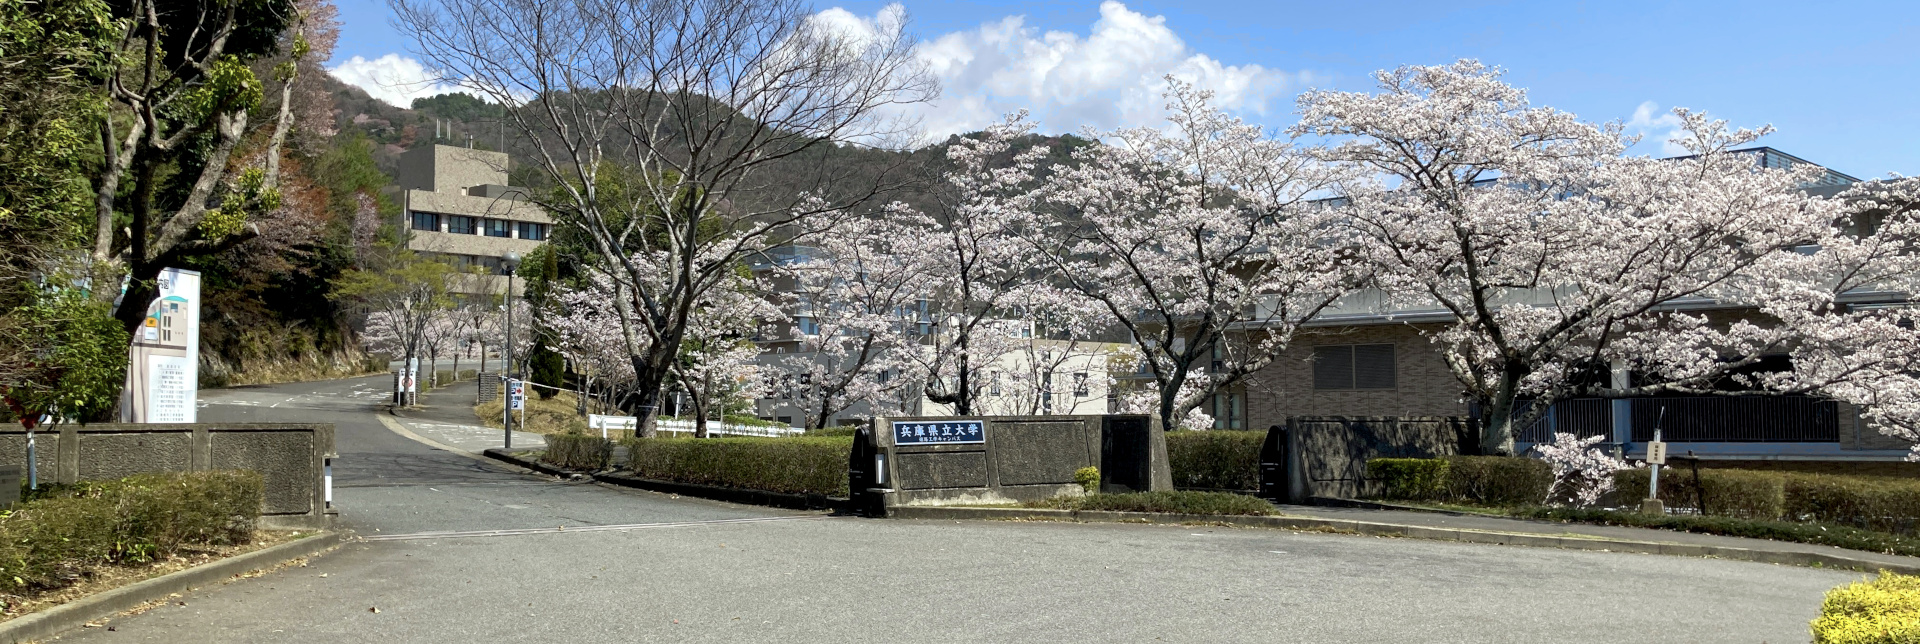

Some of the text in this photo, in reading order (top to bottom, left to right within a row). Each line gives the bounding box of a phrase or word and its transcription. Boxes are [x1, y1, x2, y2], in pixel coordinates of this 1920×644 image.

[900, 423, 979, 437] 兵庫県立大学
